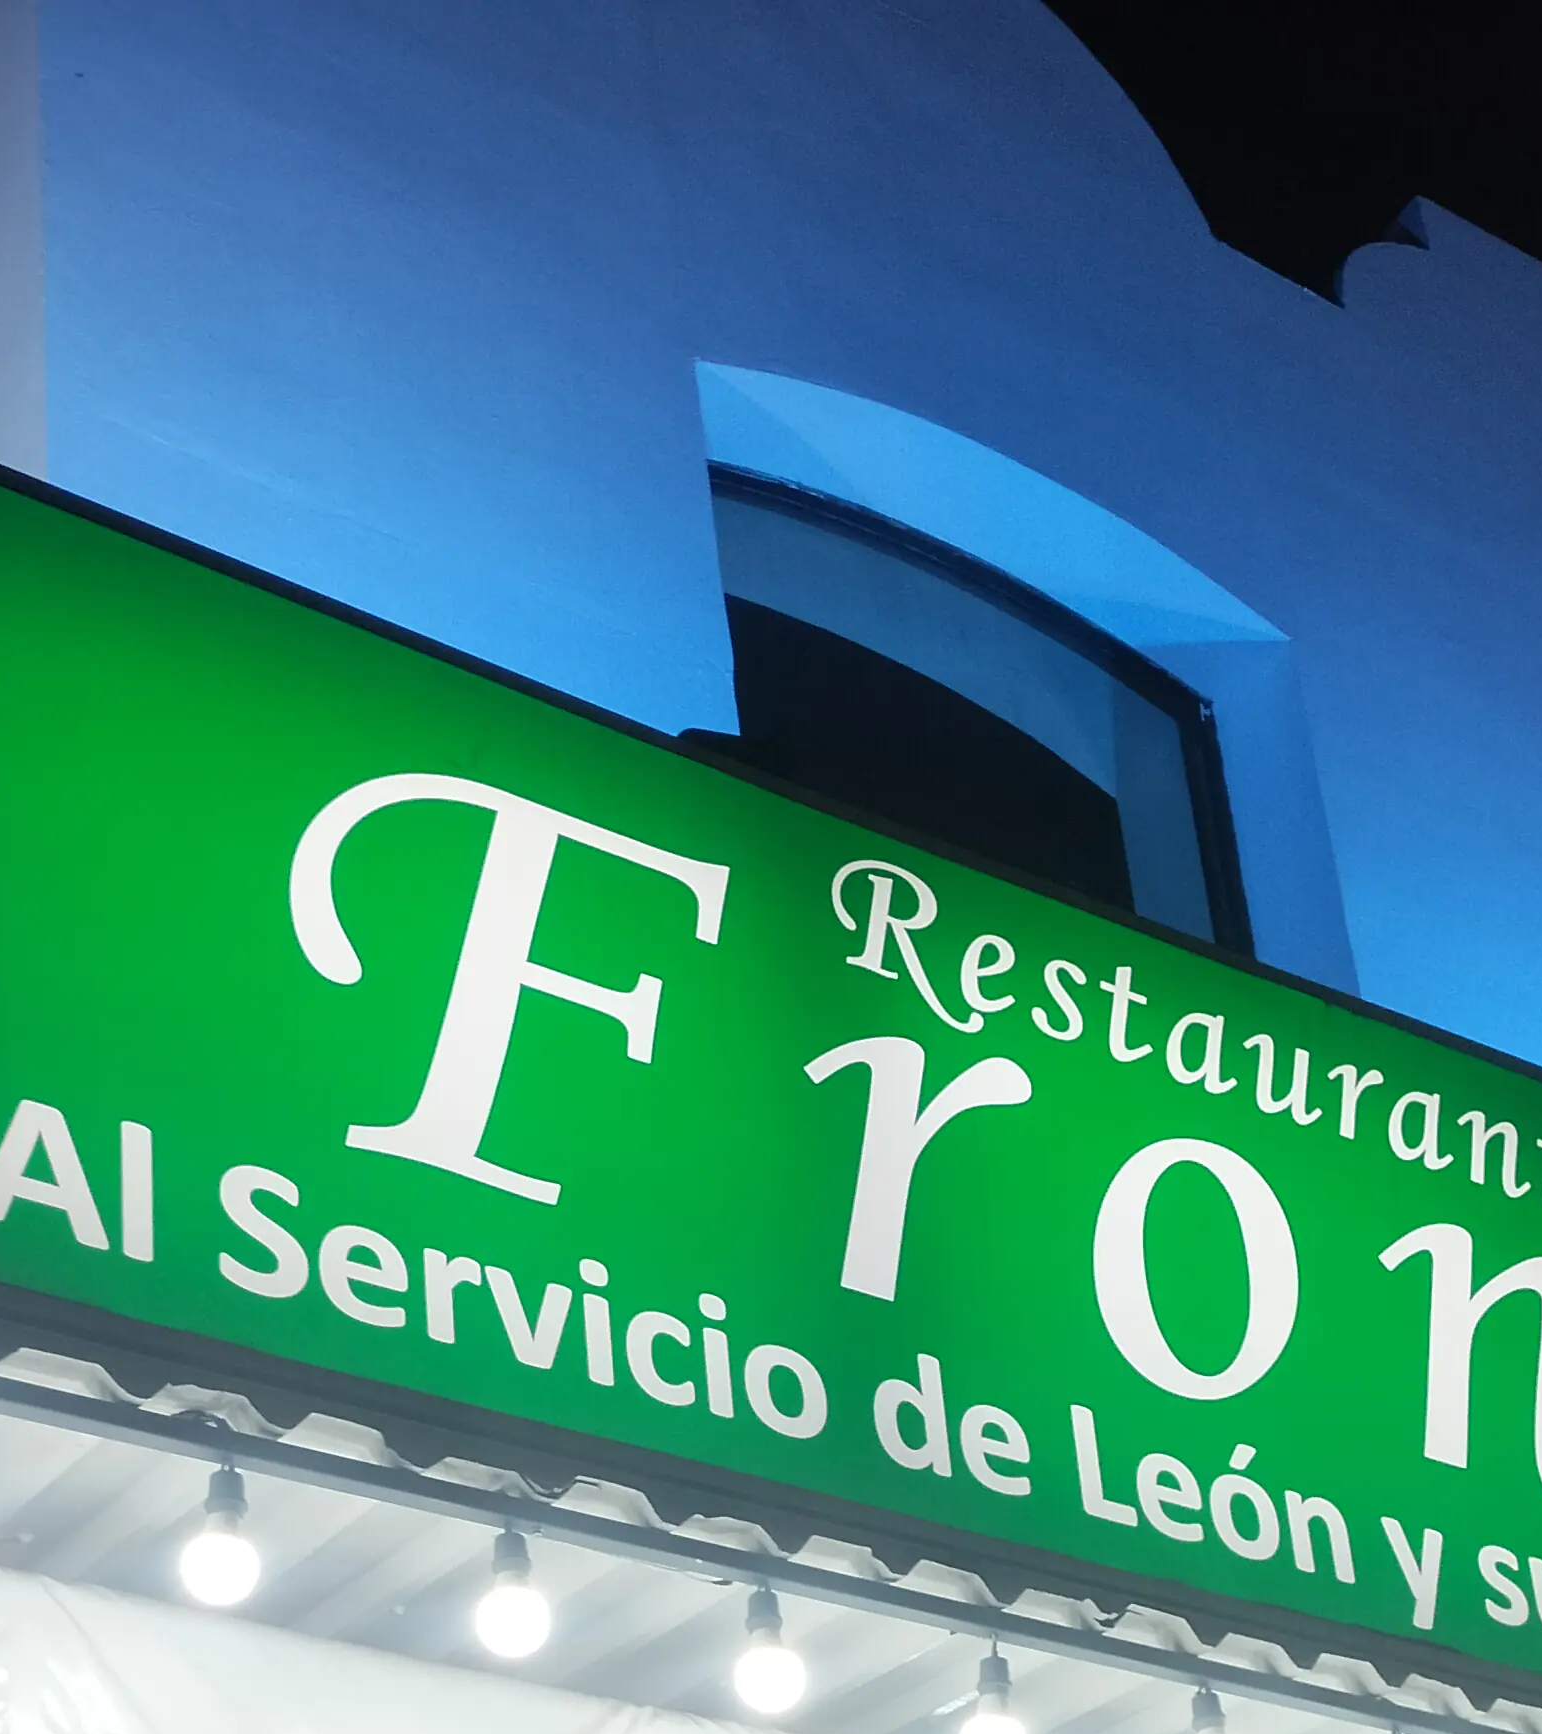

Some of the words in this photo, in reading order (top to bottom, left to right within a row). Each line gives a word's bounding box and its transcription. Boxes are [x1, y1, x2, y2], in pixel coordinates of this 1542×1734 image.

[220, 1166, 828, 1438] Servicio
[873, 1353, 1031, 1496] de
[1071, 1404, 1355, 1584] León
[1380, 1516, 1443, 1630] y
